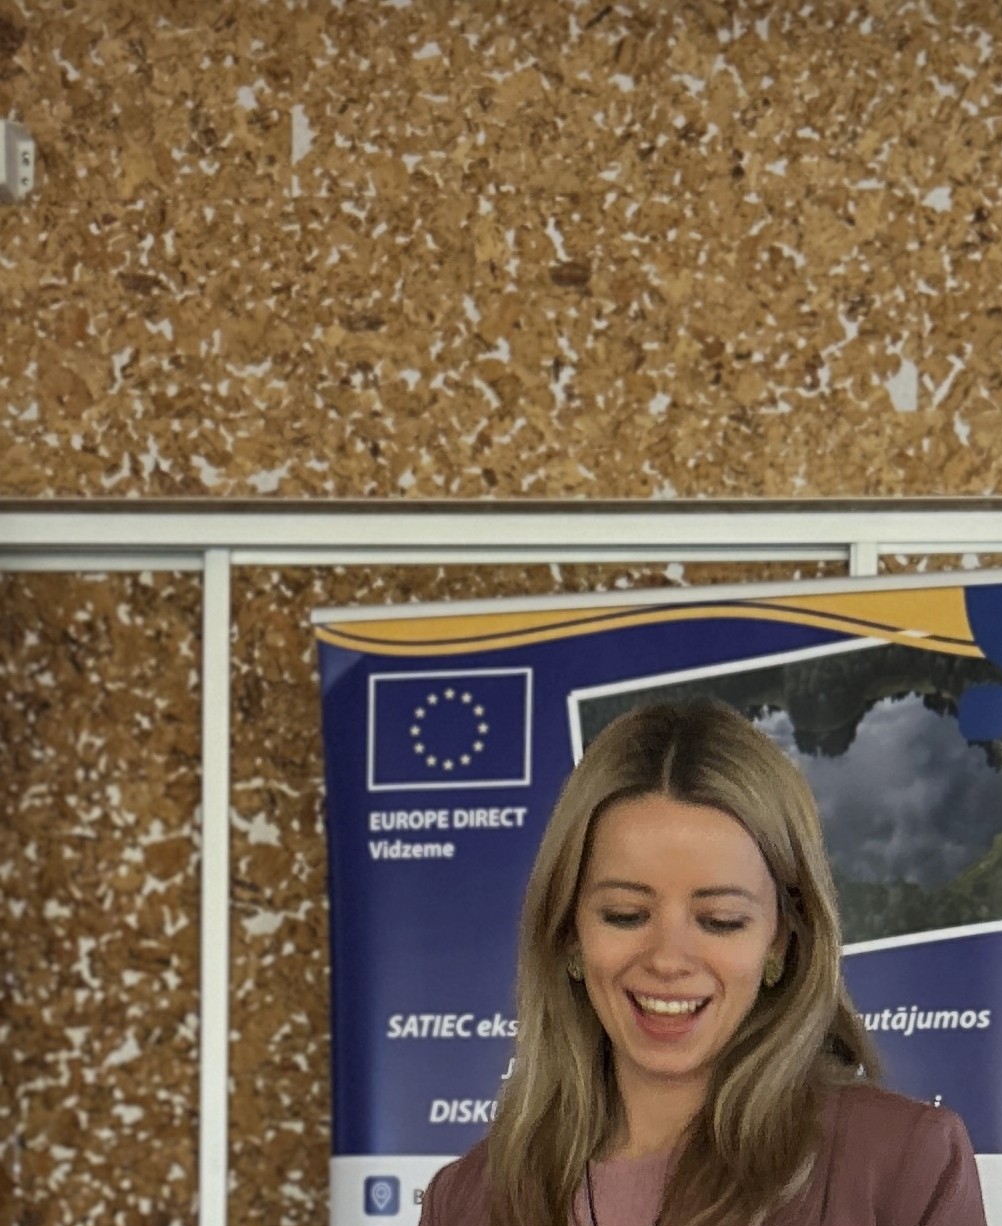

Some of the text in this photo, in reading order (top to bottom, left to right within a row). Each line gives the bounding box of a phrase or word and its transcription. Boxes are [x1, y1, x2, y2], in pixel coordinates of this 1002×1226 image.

[369, 805, 528, 832] EUROPE DIRECT
[368, 838, 455, 861] Vidzeme
[387, 1013, 475, 1039] SATIEC
[856, 1004, 992, 1037] utājumos
